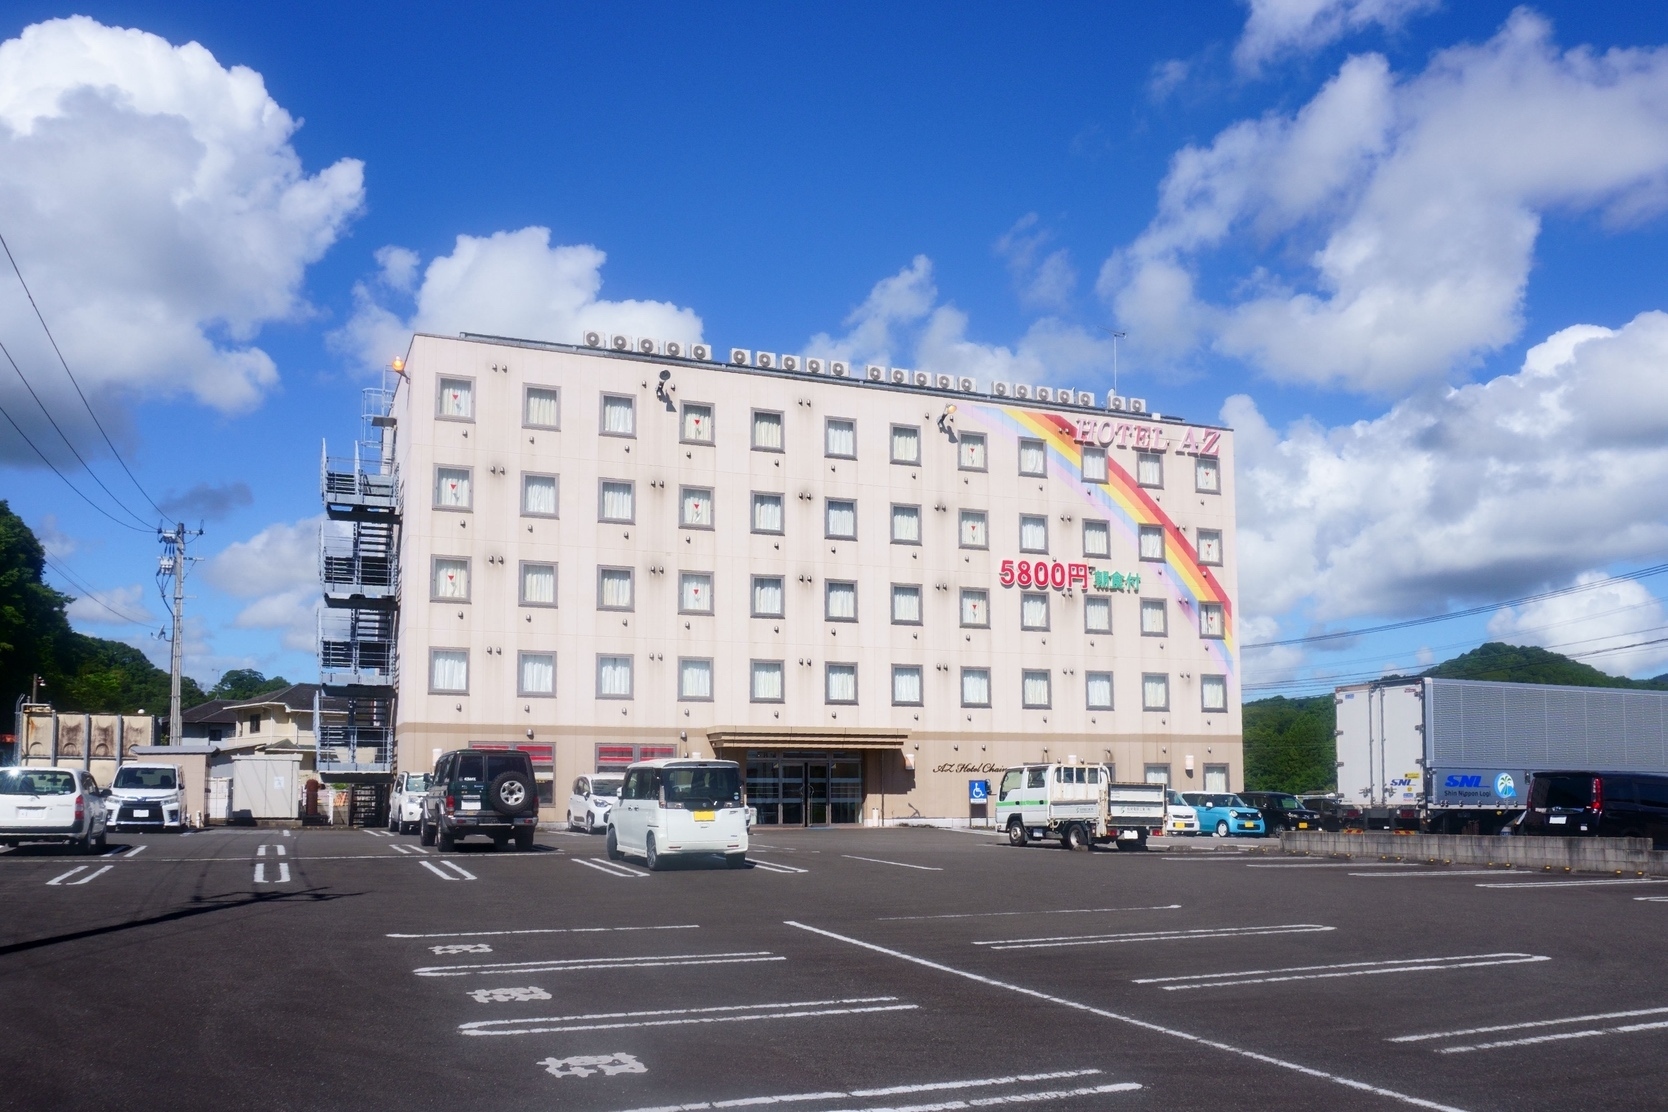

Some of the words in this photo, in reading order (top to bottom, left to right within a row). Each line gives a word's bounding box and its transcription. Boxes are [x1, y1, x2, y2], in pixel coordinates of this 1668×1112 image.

[1075, 418, 1167, 450] HOTEL
[1175, 428, 1221, 455] AZ
[1000, 559, 1088, 590] 5800円
[1093, 570, 1141, 590] 朝食付
[932, 762, 956, 774] AZ
[955, 761, 984, 774] Hotel
